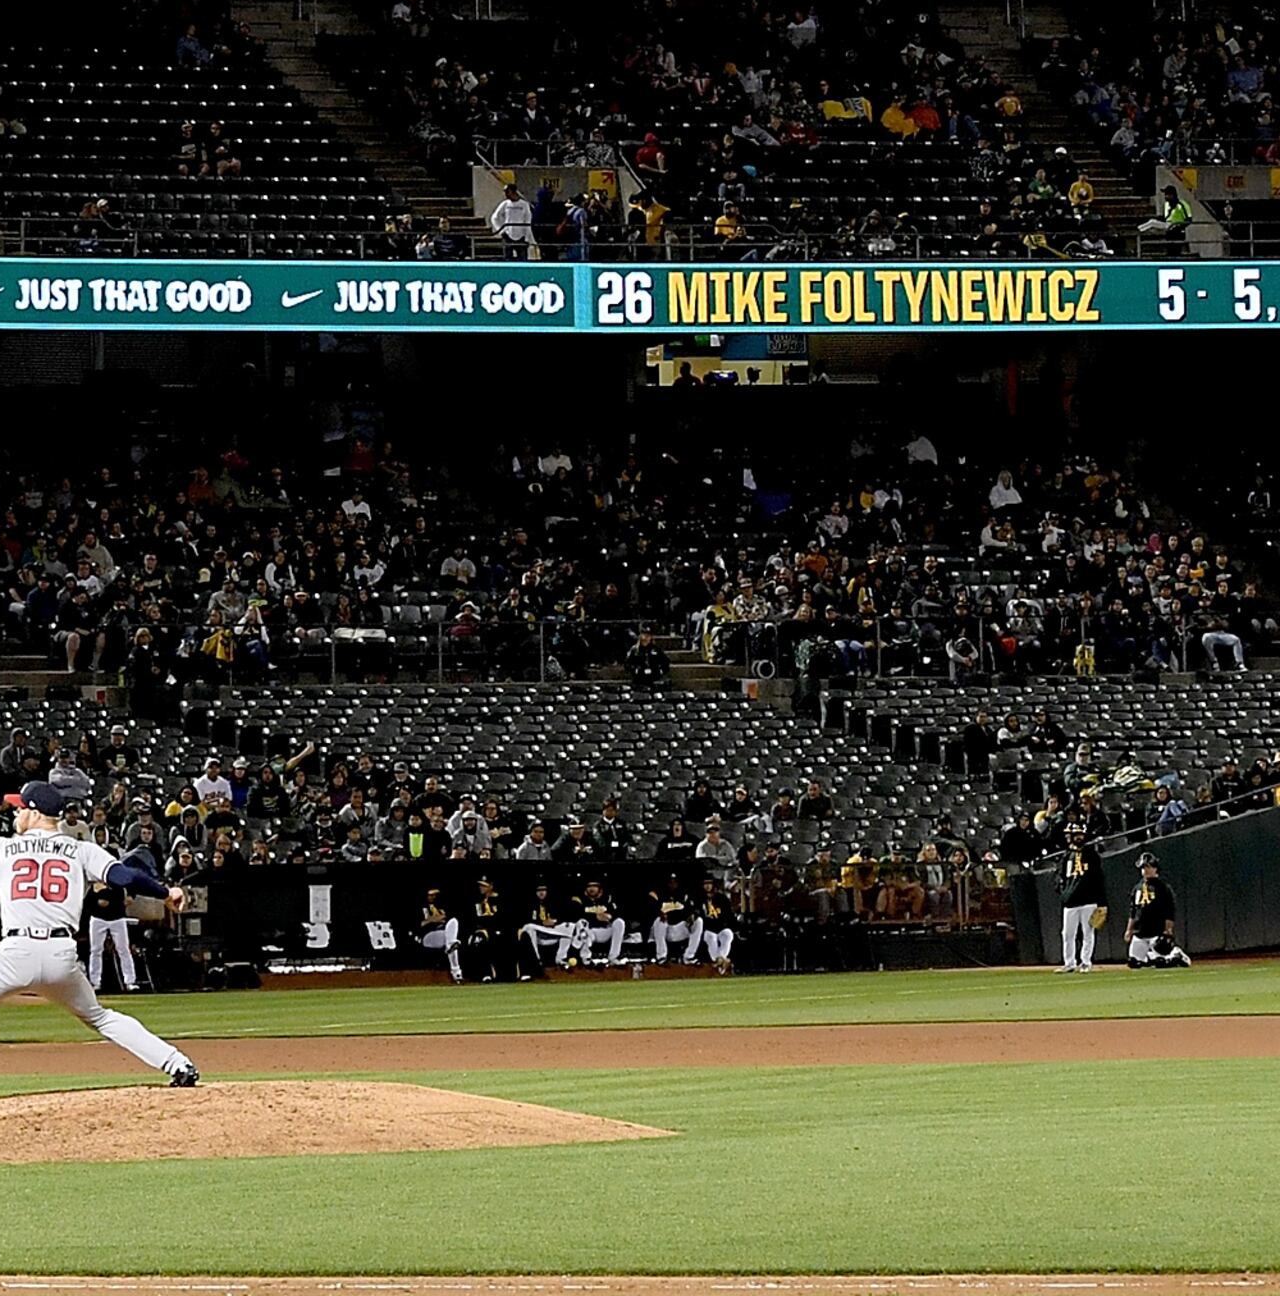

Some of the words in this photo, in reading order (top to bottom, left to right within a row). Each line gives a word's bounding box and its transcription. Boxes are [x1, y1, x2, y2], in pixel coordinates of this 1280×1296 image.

[17, 280, 82, 310] JUST
[89, 280, 159, 311] THAT
[165, 279, 251, 312] GOOD
[598, 273, 652, 323] 26
[668, 273, 788, 322] MIKE
[802, 270, 1099, 322] FOLTYNEWICZ
[5, 839, 78, 859] FOLTYNEWICZ
[11, 859, 69, 903] 26
